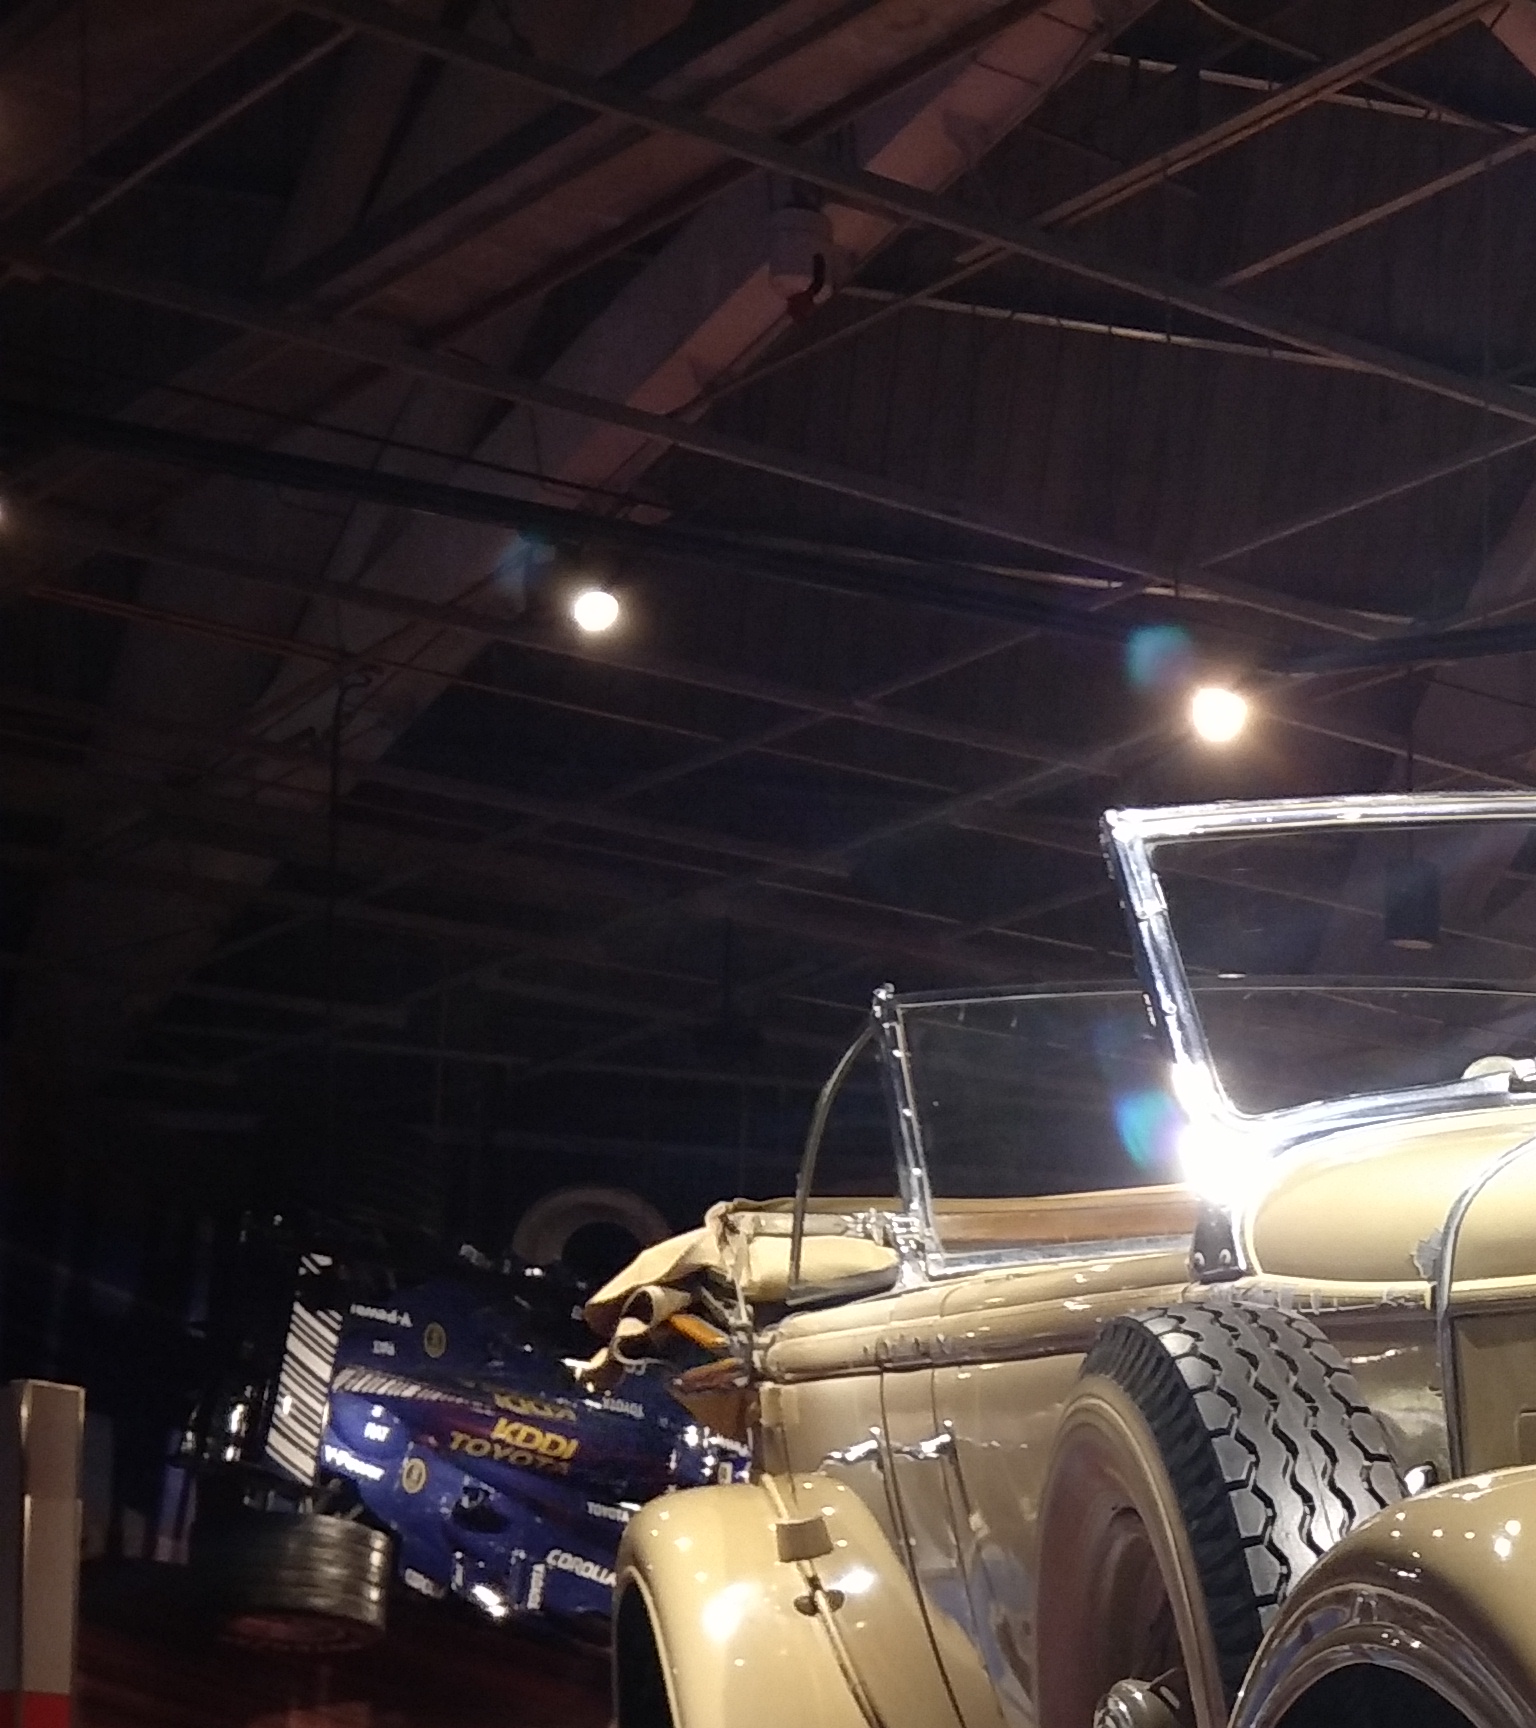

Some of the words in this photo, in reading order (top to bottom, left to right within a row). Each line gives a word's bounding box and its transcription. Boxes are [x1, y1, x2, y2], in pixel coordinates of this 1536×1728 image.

[451, 1431, 570, 1475] TOYOTA
[491, 1417, 580, 1459] KDDI
[586, 1501, 630, 1523] TOYOTA
[545, 1548, 618, 1588] COROLLA
